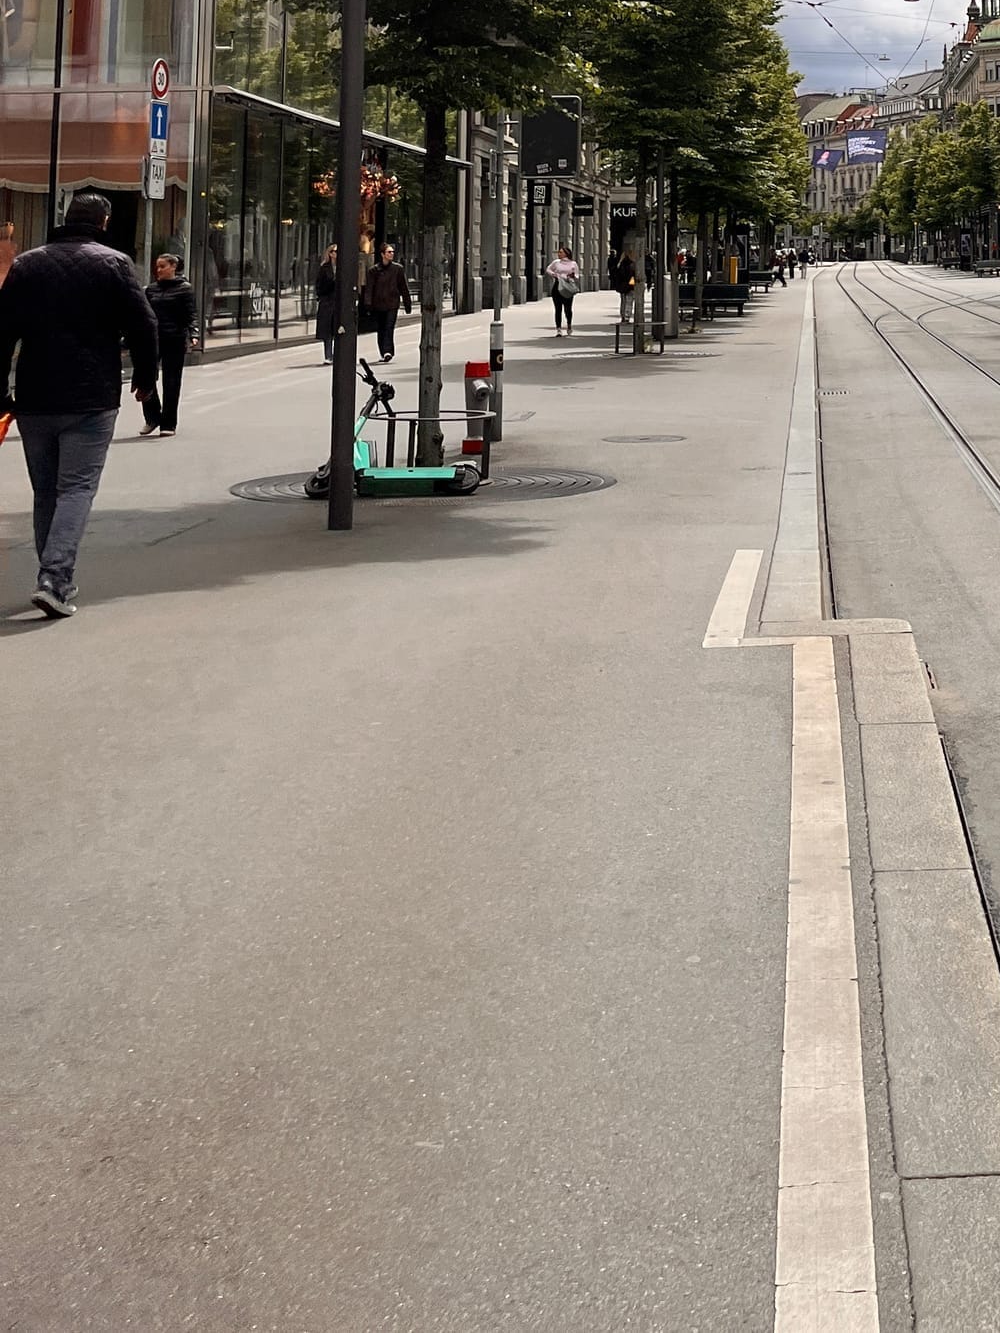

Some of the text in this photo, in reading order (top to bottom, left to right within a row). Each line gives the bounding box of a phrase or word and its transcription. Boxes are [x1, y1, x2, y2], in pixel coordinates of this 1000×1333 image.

[157, 72, 164, 85] 30
[152, 164, 164, 180] TAXI
[613, 207, 637, 217] KUR
